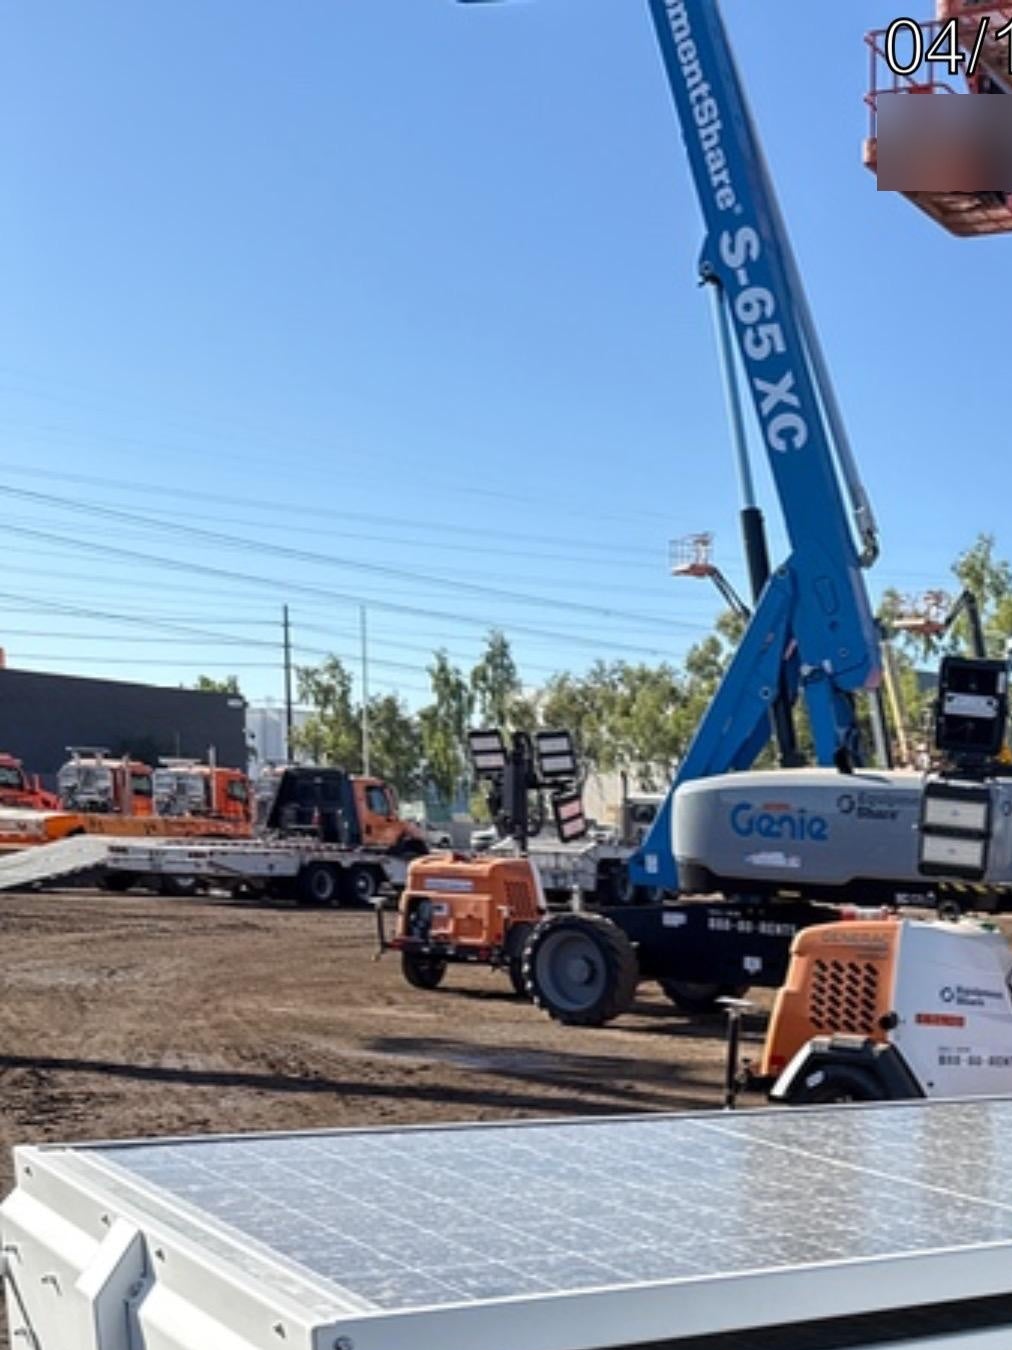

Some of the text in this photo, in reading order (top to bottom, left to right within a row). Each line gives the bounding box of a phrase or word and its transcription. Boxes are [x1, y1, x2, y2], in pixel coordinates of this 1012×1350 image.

[666, 0, 808, 453] mentShare S-65 XC
[730, 802, 829, 841] Genie
